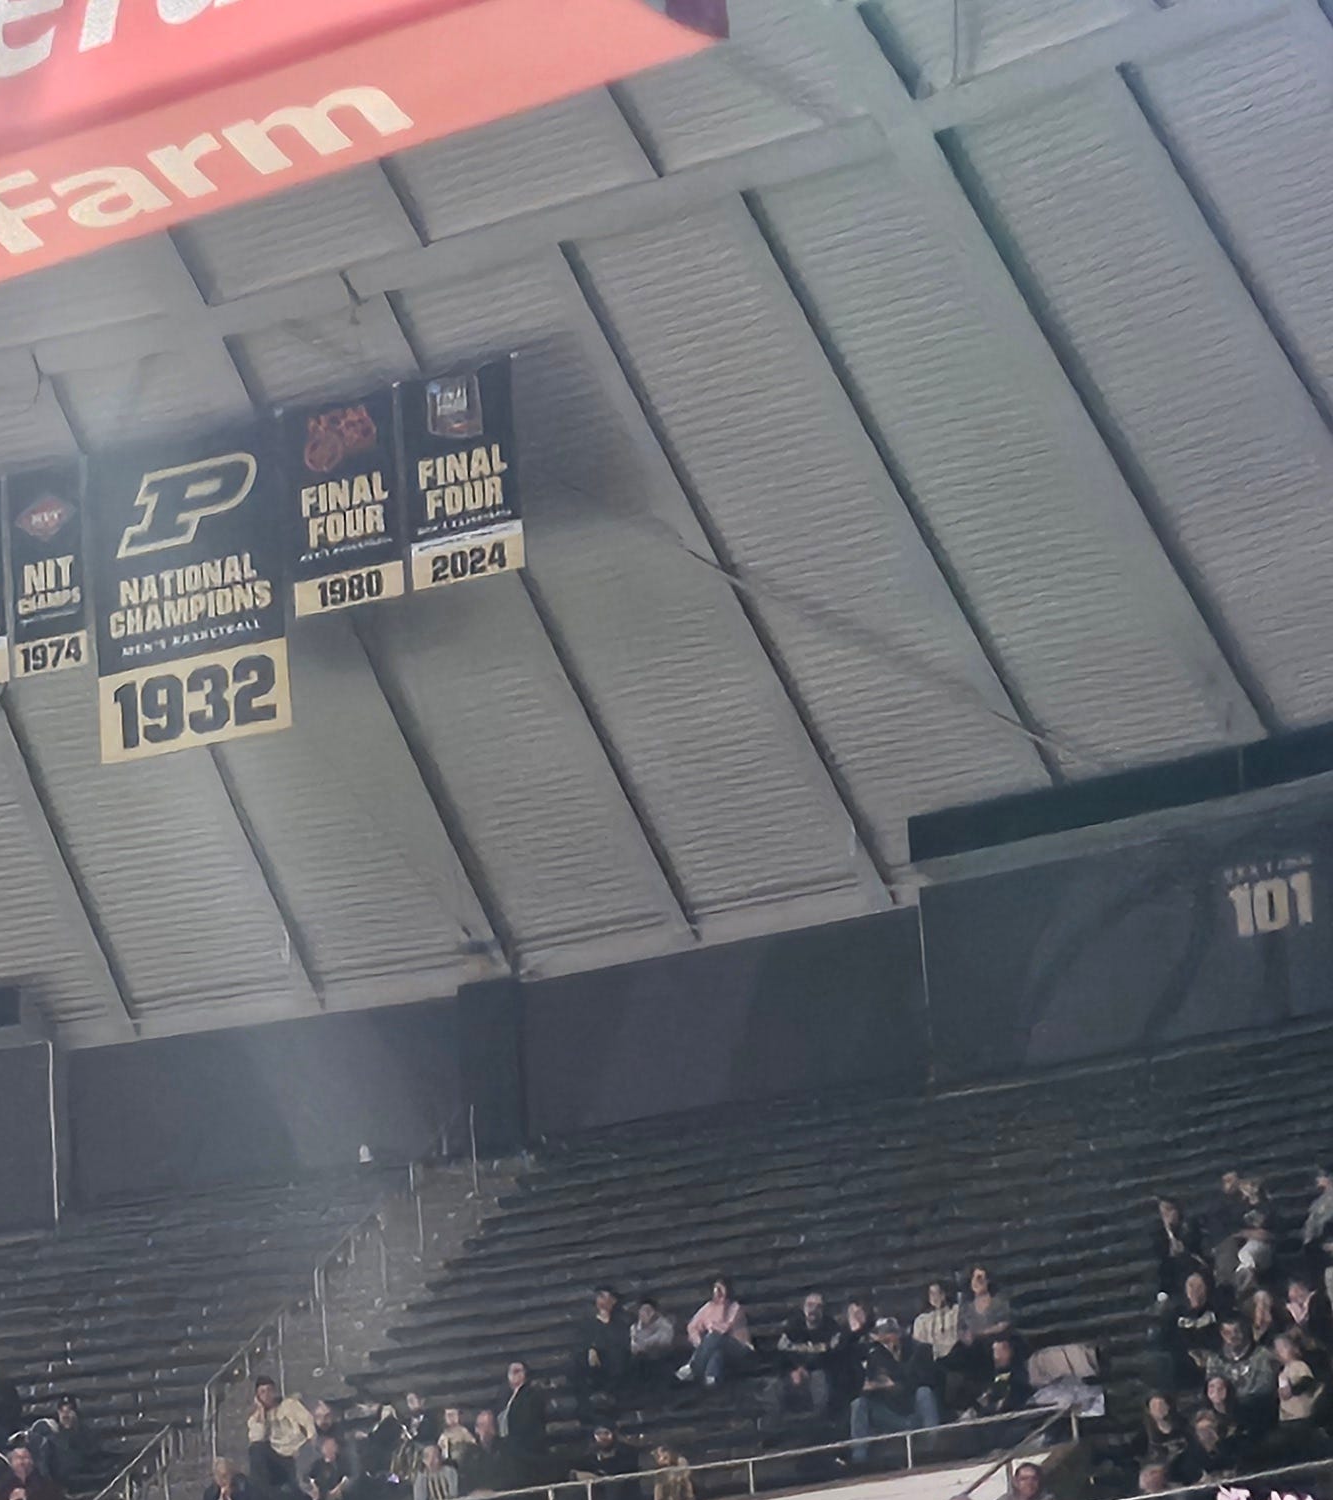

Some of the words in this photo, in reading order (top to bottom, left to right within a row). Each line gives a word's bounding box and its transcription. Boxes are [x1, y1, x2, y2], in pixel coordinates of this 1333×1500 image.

[418, 443, 508, 490] FINAL
[301, 471, 389, 518] FINAL
[426, 475, 504, 520] FOUR
[309, 504, 385, 549] FOUR
[23, 555, 75, 595] NIT
[120, 551, 258, 607] NATIONAL
[432, 541, 507, 583] 2024
[109, 580, 271, 640] CHAMPIONS
[317, 569, 384, 608] 1980
[20, 636, 83, 674] 1974
[113, 653, 278, 750] 1932
[1228, 871, 1313, 938] 101
